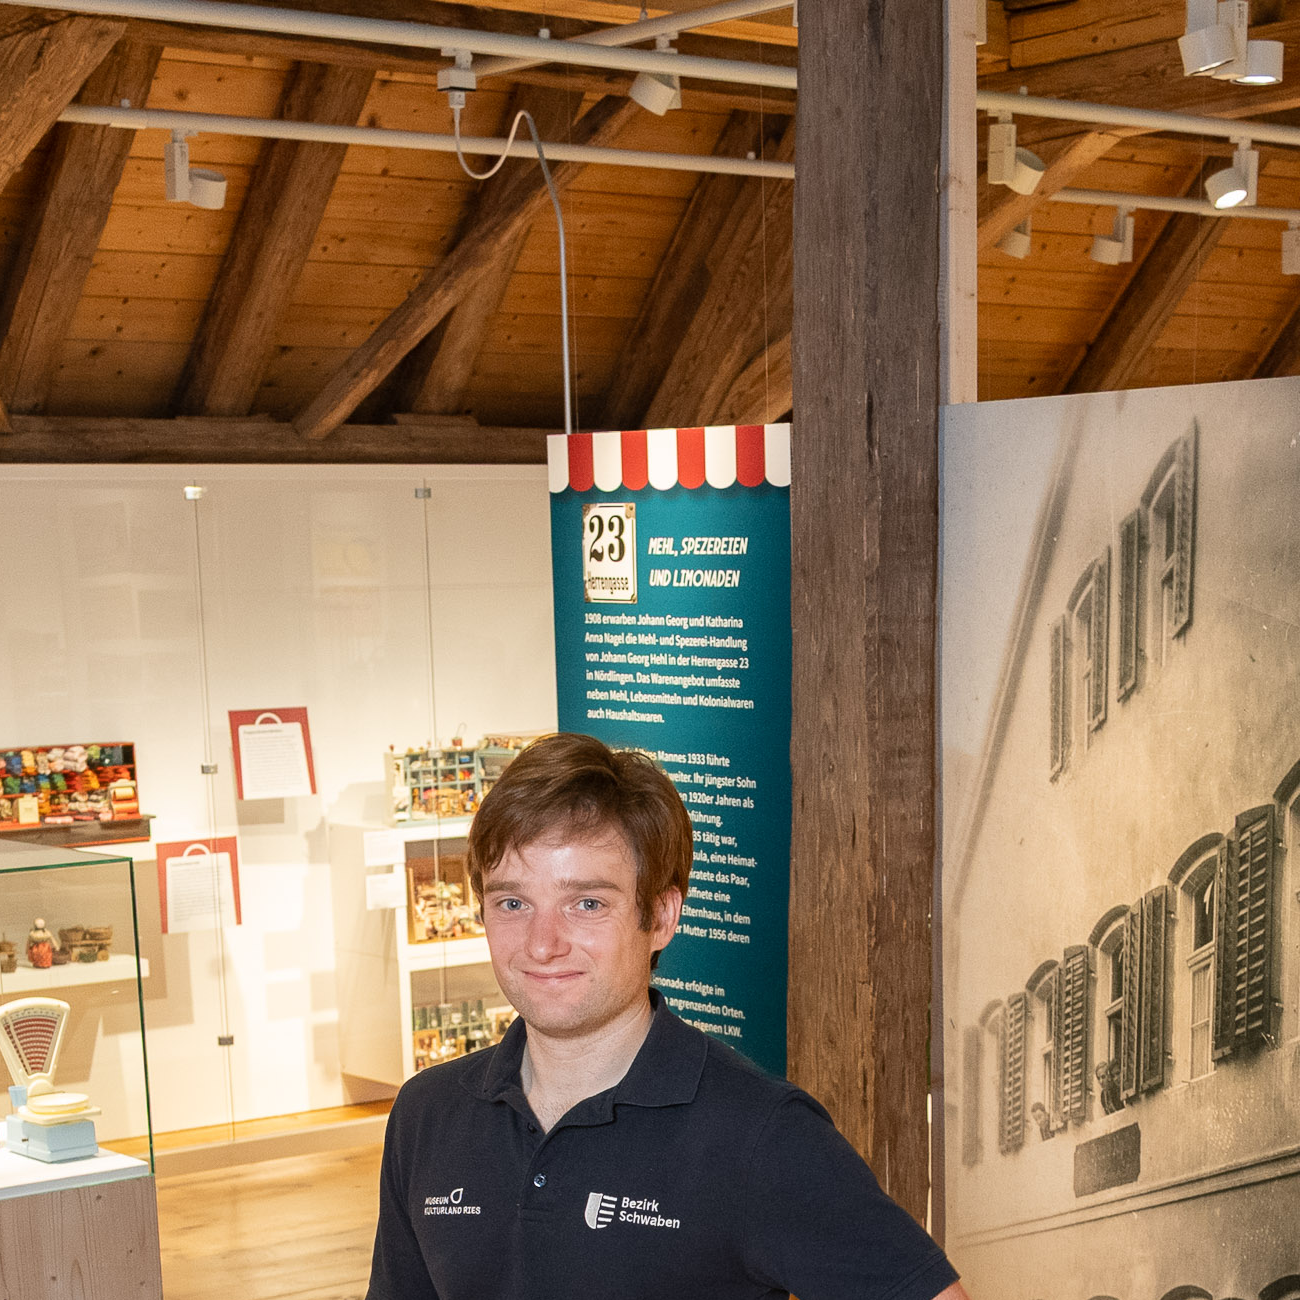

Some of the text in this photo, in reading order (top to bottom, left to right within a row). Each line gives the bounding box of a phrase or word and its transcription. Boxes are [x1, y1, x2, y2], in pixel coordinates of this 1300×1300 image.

[589, 515, 625, 562] 23
[647, 537, 748, 556] MEHL, SPEZEREIEN
[648, 569, 740, 586] UND LIMONADEN
[584, 613, 742, 629] 1908 erwarben Johann Georg und Katharina
[584, 632, 747, 650] Anna Nagel die Mehl- und Spezerei-Handlung
[584, 651, 748, 670] von Johann Georg Hehl in der Herrengasse 23
[586, 669, 740, 688] in Nördlingen. Das Warenangebot umfasste
[586, 688, 753, 708] neben Mehl, Lebensmitteln und Kolonialwaren
[586, 707, 664, 722] auch Haushaltswaren.
[656, 750, 686, 763] Mannes
[687, 753, 705, 764] 1933
[706, 753, 729, 766] führte
[693, 772, 704, 783] Ihr
[704, 773, 735, 788] jüngster
[736, 776, 756, 787] Sohn
[688, 791, 714, 804] 1920er
[714, 794, 741, 806] Jahren
[742, 796, 754, 808] als
[701, 831, 720, 846] tätig
[720, 836, 737, 846] war,
[709, 852, 726, 863] eine
[727, 854, 757, 866] Heimat-
[715, 871, 729, 883] das
[730, 873, 749, 886] Paar,
[713, 890, 730, 902] eine
[681, 904, 750, 923] Elternhaus, in dem
[682, 923, 707, 936] Mutter
[708, 928, 726, 940] 1956
[727, 930, 749, 943] deren
[684, 980, 713, 996] erfolgte
[714, 984, 724, 995] im
[669, 997, 745, 1018] angrenzenden Orten.
[723, 1024, 741, 1036] LKW.
[425, 1196, 449, 1205] MUSEUM
[621, 1196, 659, 1213] Bezirk
[463, 1205, 481, 1215] RIES
[619, 1210, 680, 1229] Schwaben
